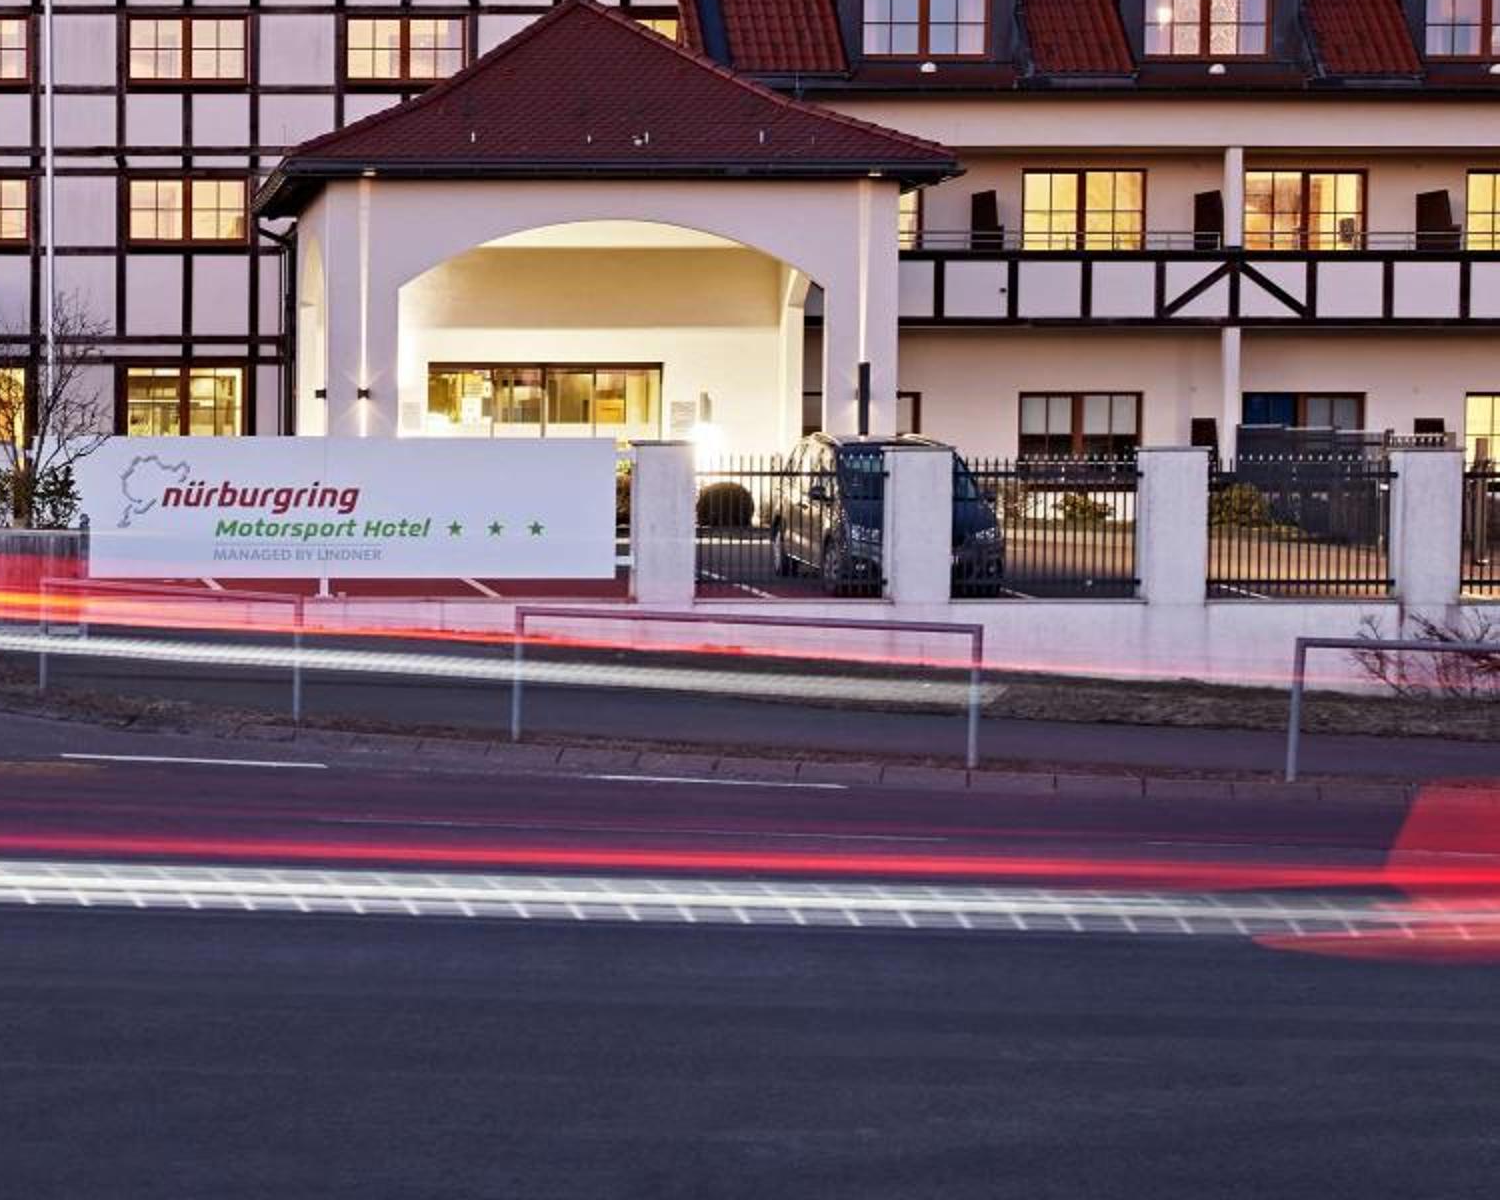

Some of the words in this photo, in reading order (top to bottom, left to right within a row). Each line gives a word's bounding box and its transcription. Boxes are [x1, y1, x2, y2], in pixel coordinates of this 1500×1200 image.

[161, 481, 360, 515] nürburgring
[215, 519, 357, 541] Motorsport
[363, 518, 431, 537] Hotel
[213, 549, 291, 561] MANAGED
[296, 549, 312, 561] BY
[317, 549, 382, 561] LINDNER
